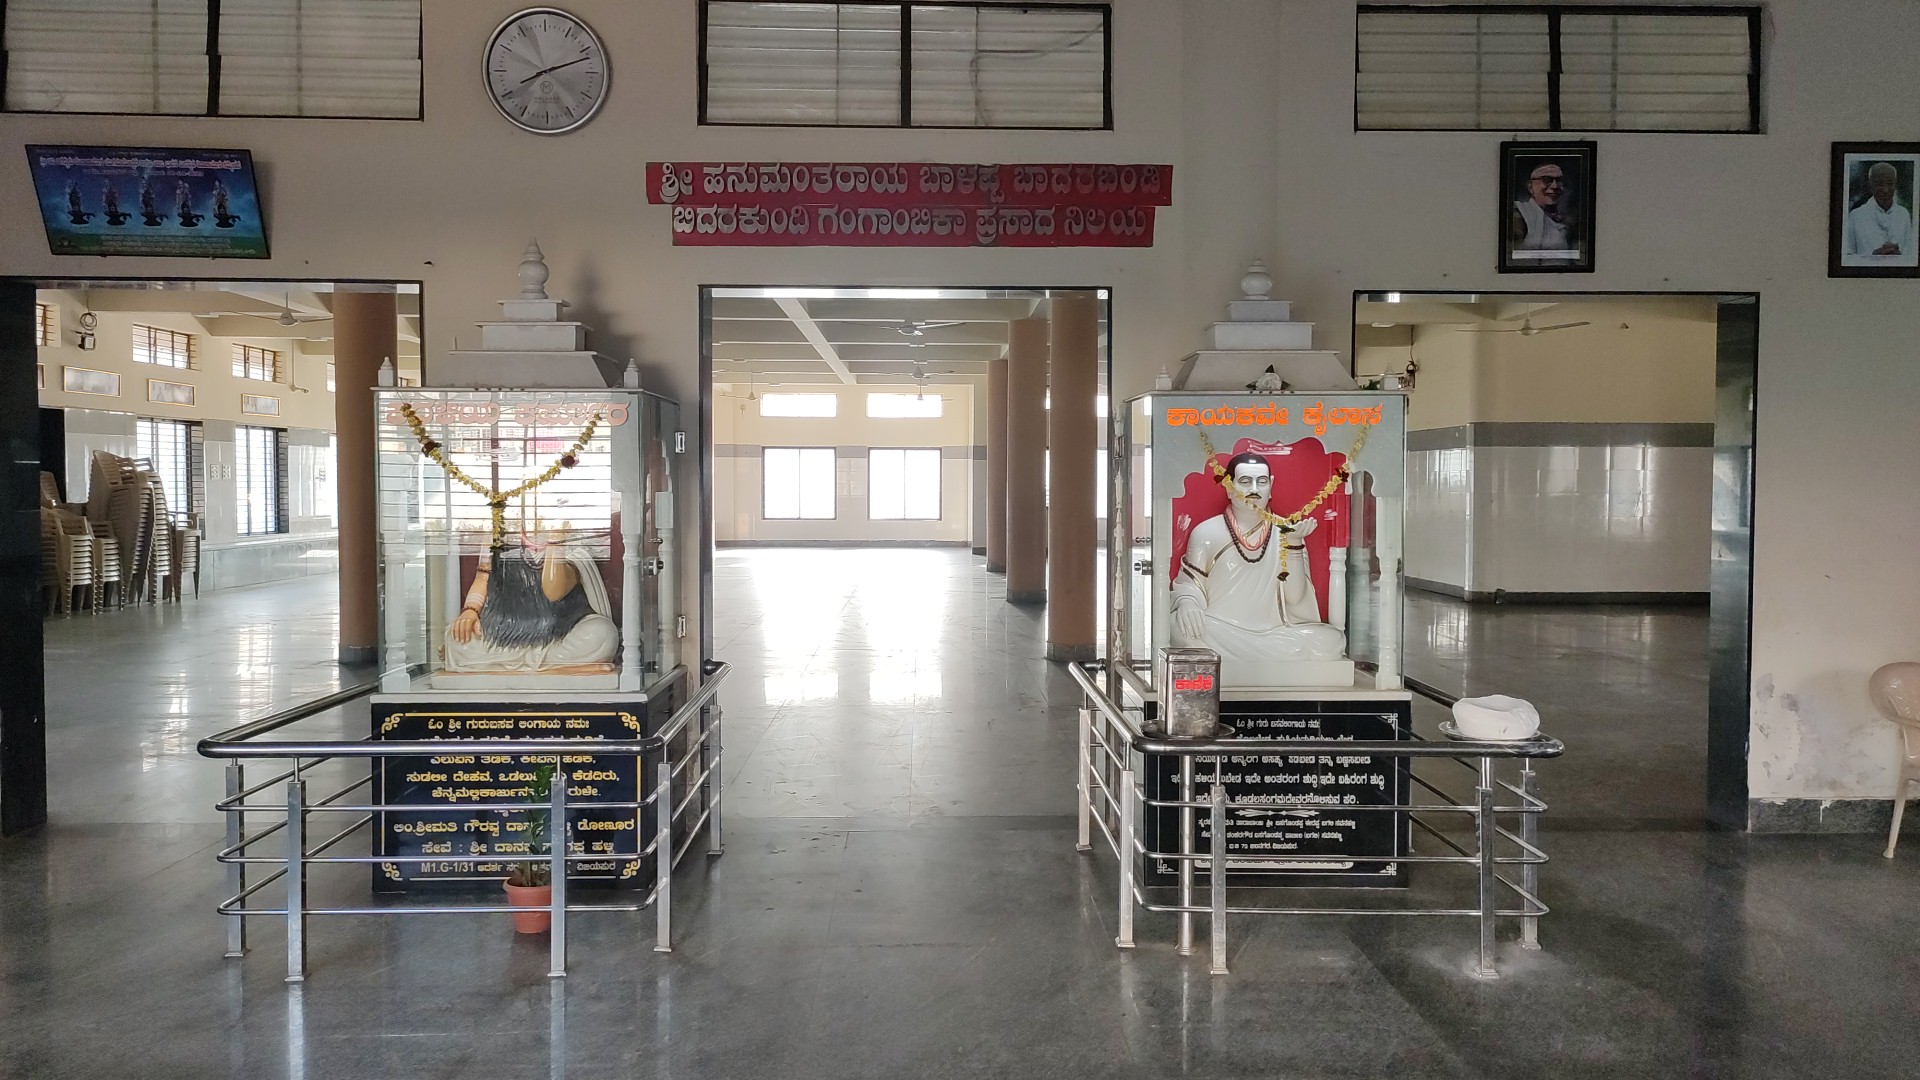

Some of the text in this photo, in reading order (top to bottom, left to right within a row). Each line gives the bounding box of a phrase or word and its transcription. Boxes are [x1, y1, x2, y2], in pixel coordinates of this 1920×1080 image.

[659, 162, 694, 203] ಶ್ರೀ
[703, 163, 908, 193] ಹನುಮಂತರಾಯ
[673, 203, 1147, 245] ಬಿದರಕುಂದಿ ಗಂಗಾಂಬಿಕಾ ಪ್ರಸಾದ ನಿಲಯ
[1166, 401, 1384, 437] ಕಾಯಕವೇ ಕೈಲಾಸ
[428, 718, 443, 730] ಓಂ
[448, 718, 462, 732] ಶ್ರೀ
[565, 718, 590, 730] ನಮಃ
[421, 840, 453, 854] ಸೇವೆ
[468, 840, 489, 857] ಶ್ರೀ
[421, 861, 474, 874] M1.G-1/31
